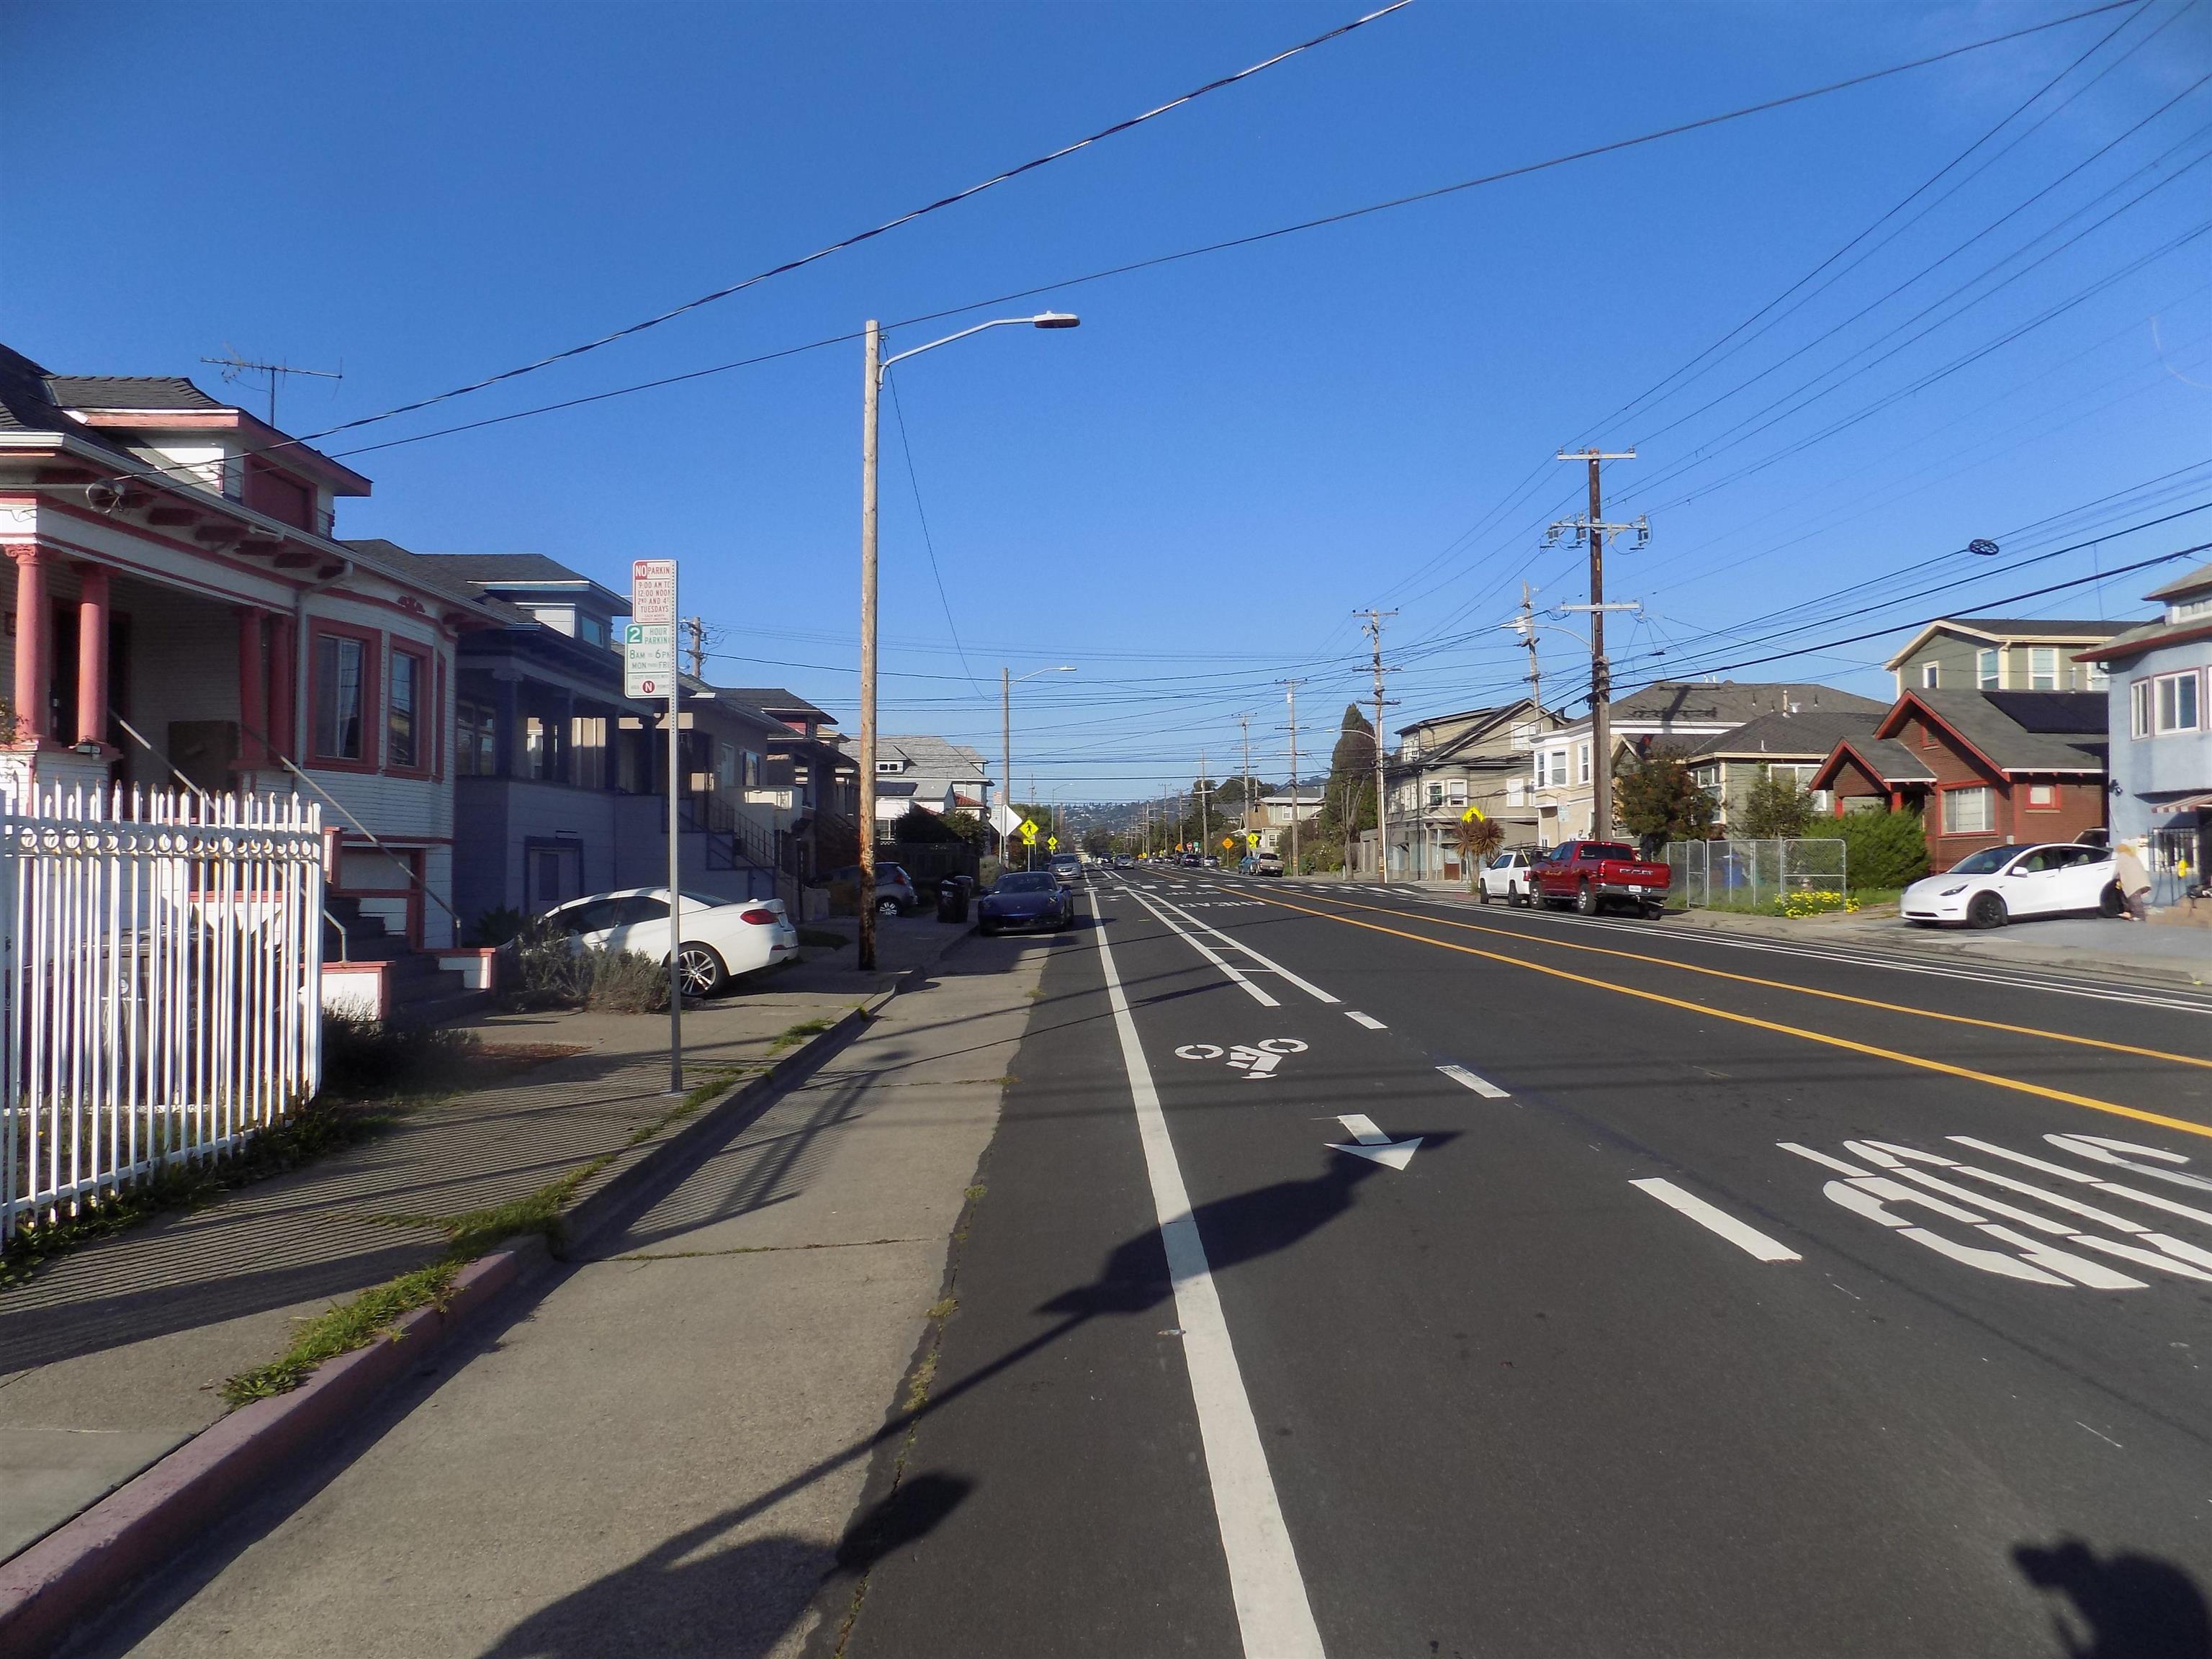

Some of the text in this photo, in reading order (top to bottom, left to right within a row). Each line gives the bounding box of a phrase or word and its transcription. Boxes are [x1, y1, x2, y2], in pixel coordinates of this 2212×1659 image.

[636, 565, 647, 577] NO
[629, 627, 667, 642] 2 HOUR
[644, 682, 652, 692] N
